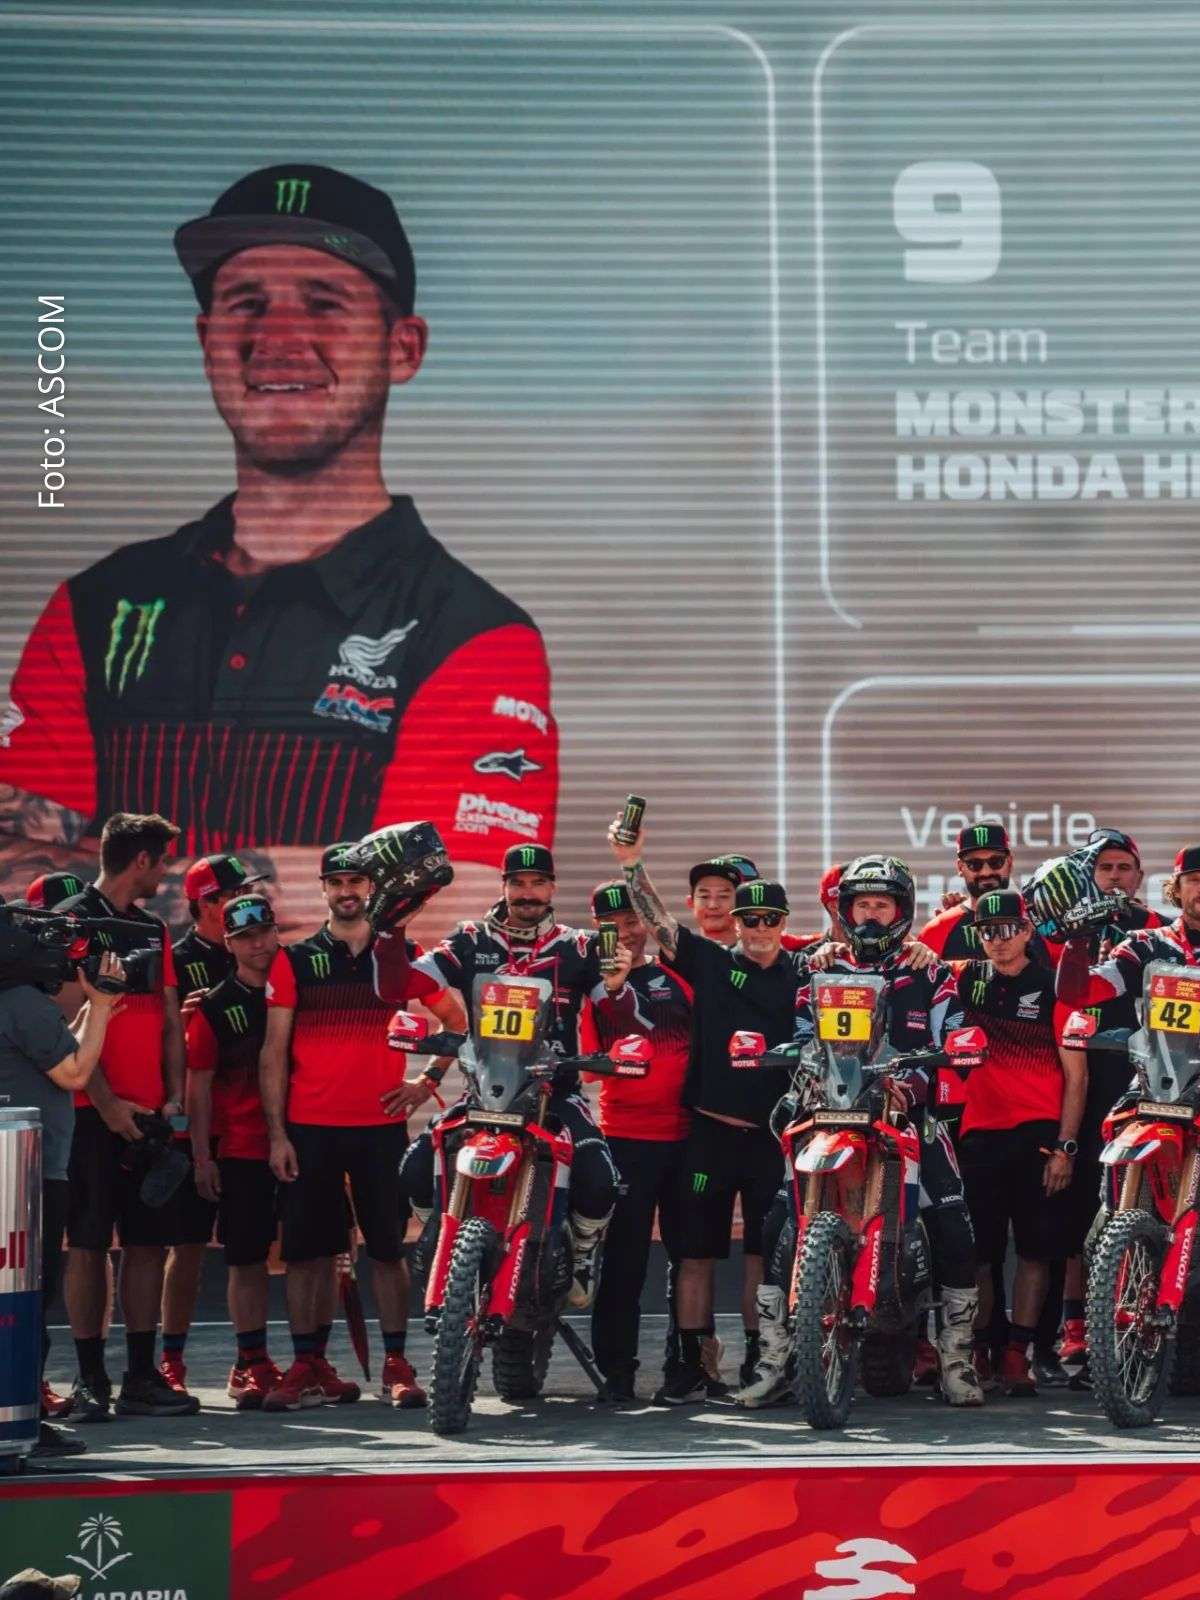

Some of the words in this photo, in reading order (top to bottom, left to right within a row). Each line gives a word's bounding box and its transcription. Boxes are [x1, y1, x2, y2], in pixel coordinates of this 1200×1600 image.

[893, 161, 1001, 282] 9
[895, 320, 1048, 364] Team
[897, 452, 1129, 500] HONDA
[492, 1010, 522, 1036] 10
[837, 1011, 851, 1036] 9
[1160, 1001, 1192, 1029] 42
[953, 1057, 982, 1066] MOTUL
[509, 1238, 527, 1301] HONDA
[868, 1230, 881, 1293] HONDA
[1176, 1227, 1194, 1290] HONDA
